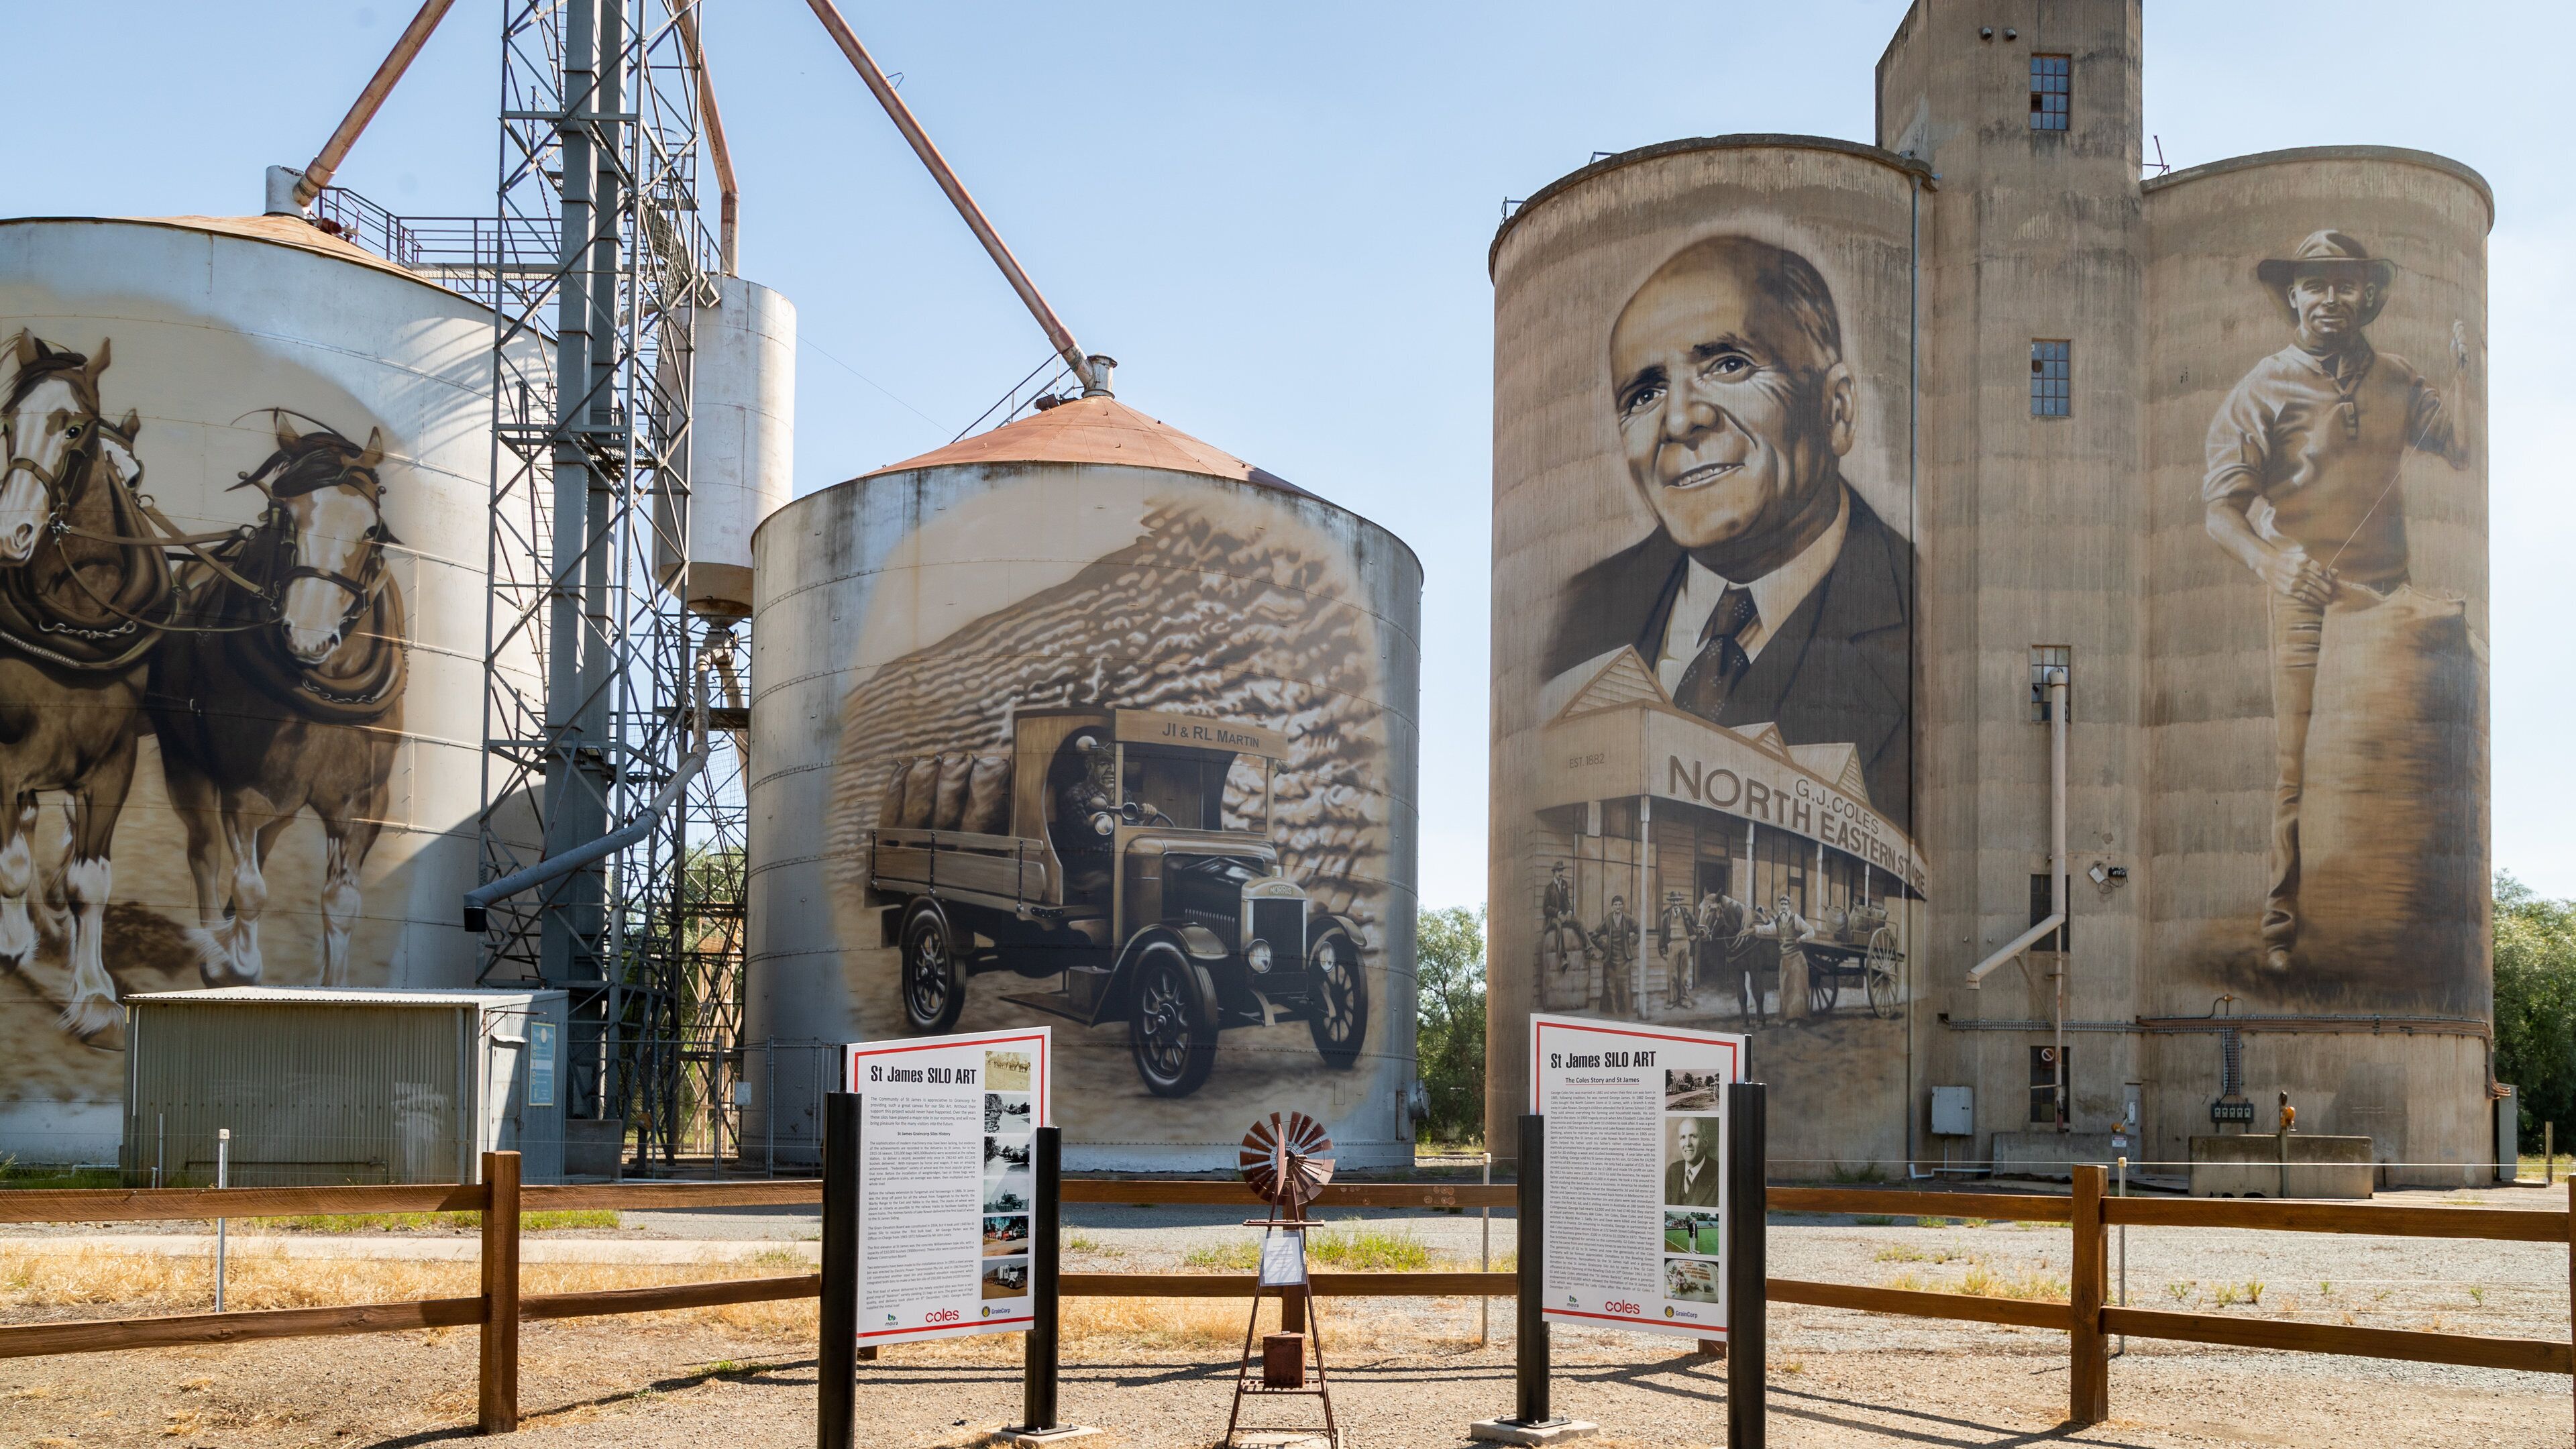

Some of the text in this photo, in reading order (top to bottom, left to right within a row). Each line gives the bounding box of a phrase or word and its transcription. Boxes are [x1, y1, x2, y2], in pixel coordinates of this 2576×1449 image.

[1180, 727, 1189, 738] &
[1193, 726, 1212, 741] RL
[1668, 755, 1811, 833] NORTH
[1821, 811, 1896, 871] EASTERN
[1270, 885, 1292, 894] MORRIS
[1551, 1051, 1656, 1068] St James SILO ART
[871, 1065, 977, 1084] St James SILO ART
[1605, 1299, 1640, 1314] coles
[1676, 1310, 1698, 1318] GrainCorp
[926, 1308, 959, 1322] coles
